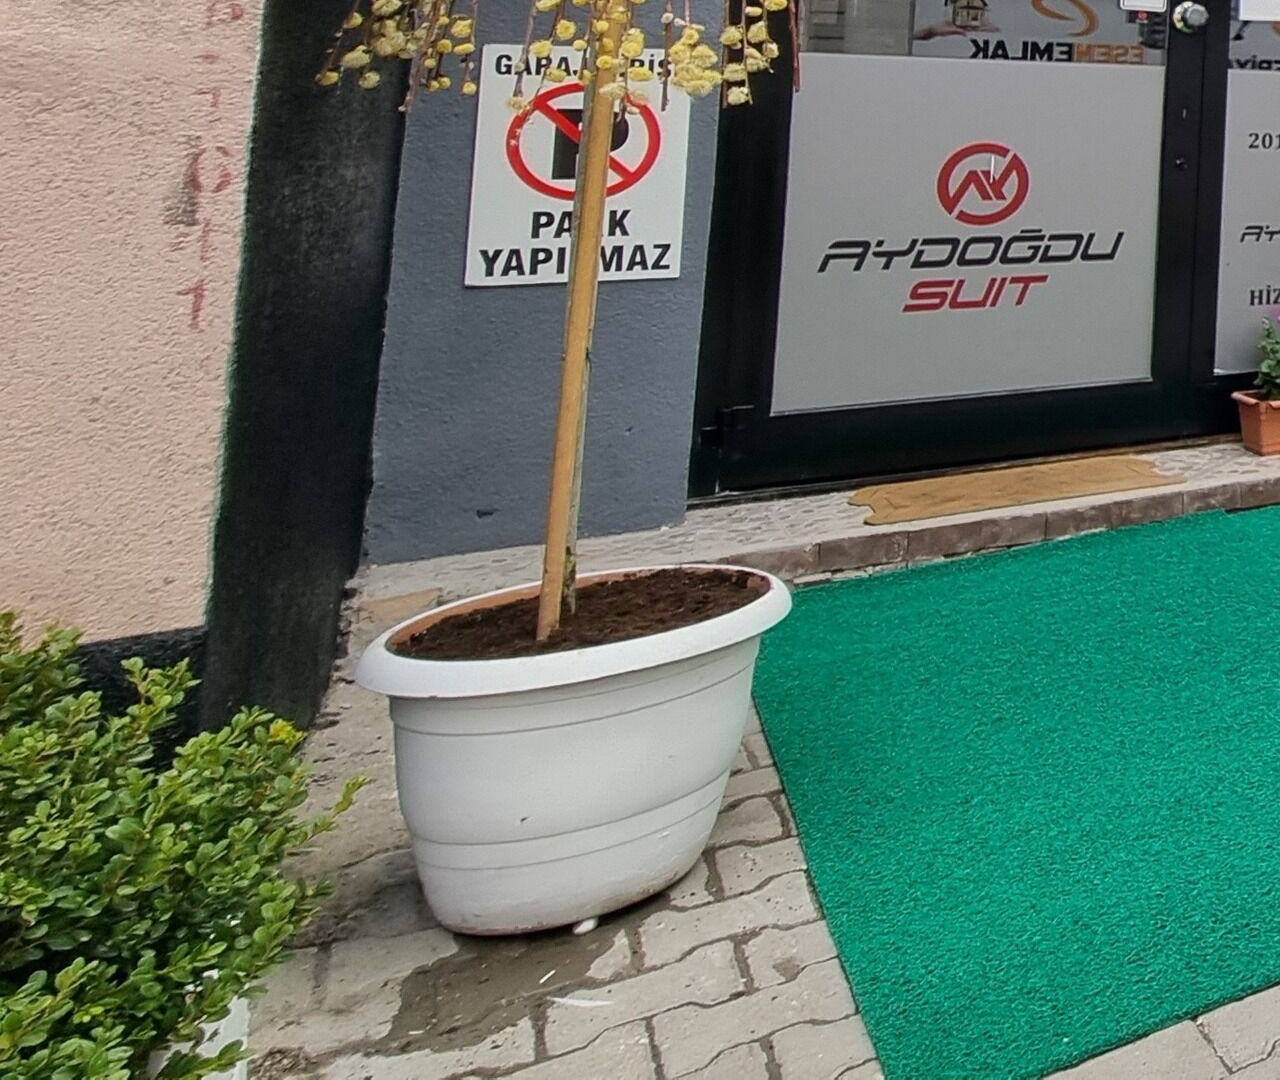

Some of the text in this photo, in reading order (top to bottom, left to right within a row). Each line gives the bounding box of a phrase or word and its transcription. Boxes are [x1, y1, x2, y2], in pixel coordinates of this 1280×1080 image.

[531, 209, 631, 239] PAK
[479, 243, 672, 277] YAPIMAZ
[817, 228, 1125, 273] AYDOĞDU
[902, 275, 1050, 313] SUIT
